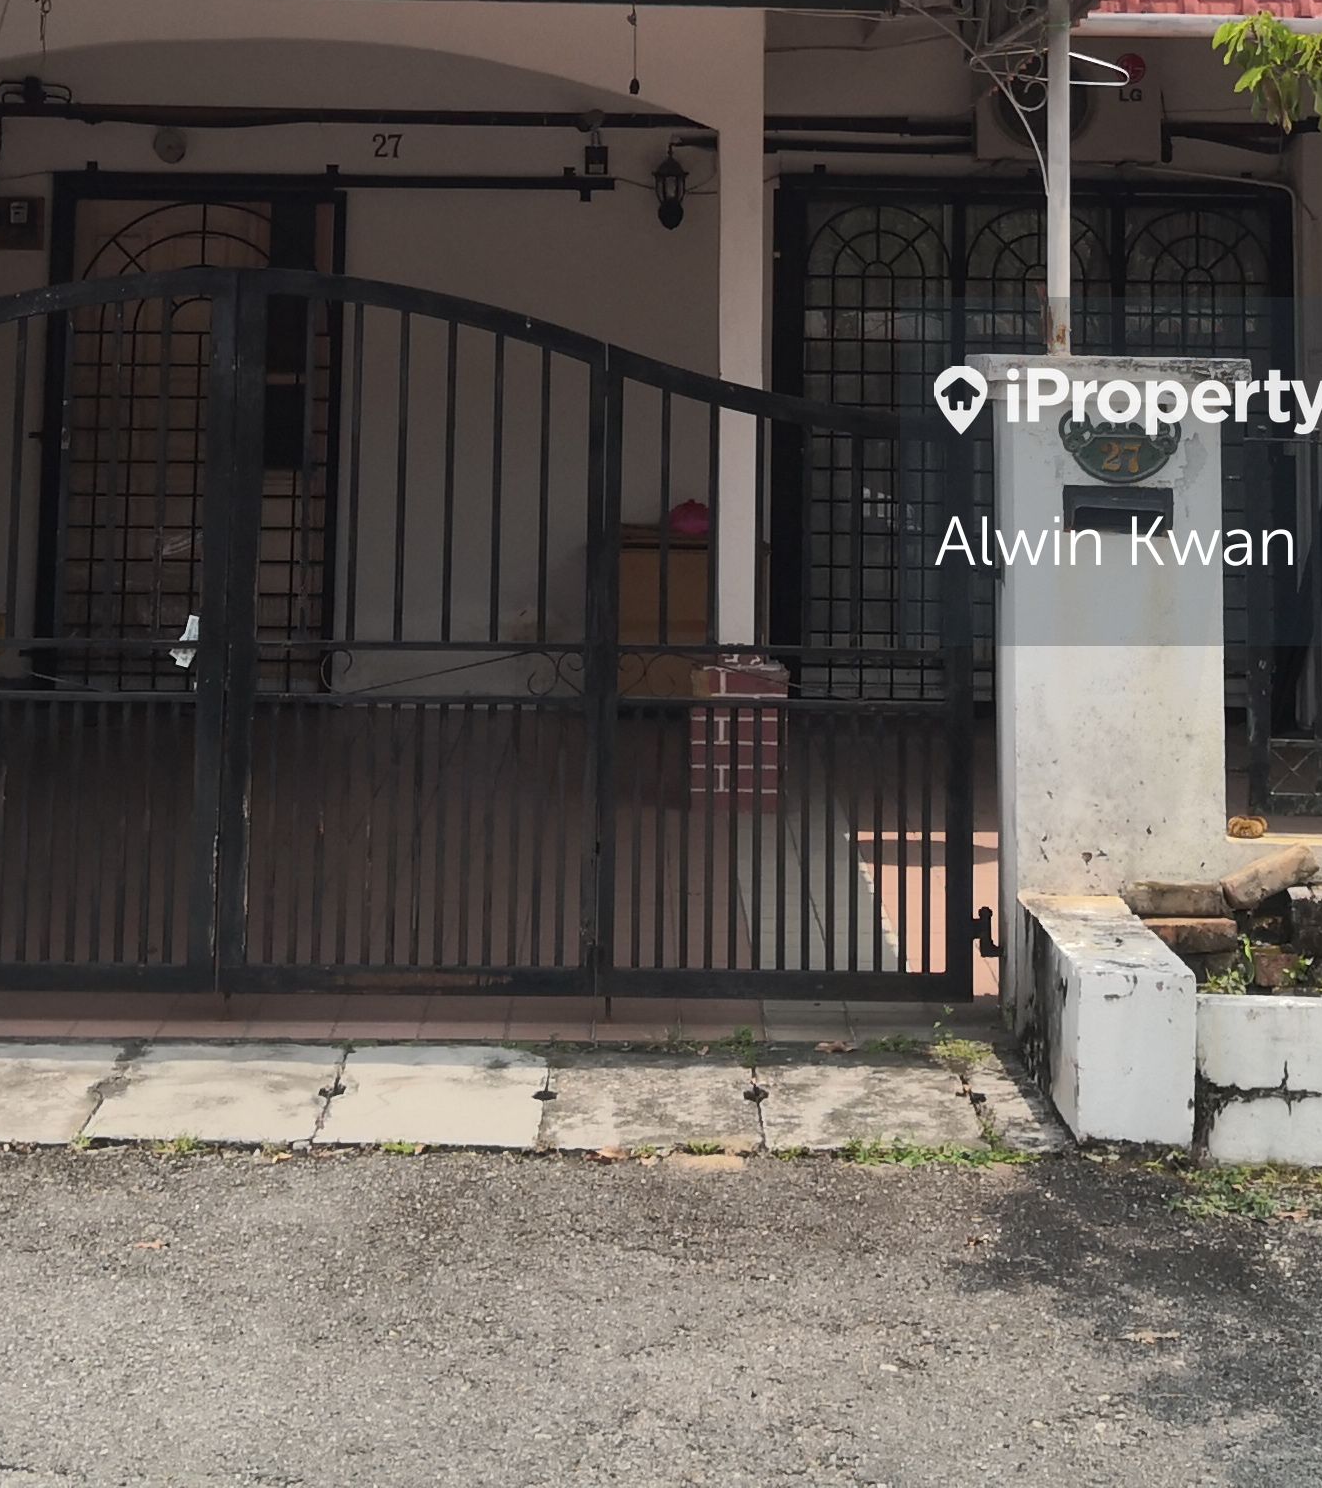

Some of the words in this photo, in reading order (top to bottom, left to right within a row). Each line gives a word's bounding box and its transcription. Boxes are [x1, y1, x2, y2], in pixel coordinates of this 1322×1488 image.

[1119, 88, 1142, 102] LG
[372, 133, 403, 159] 27
[1099, 441, 1142, 474] 27
